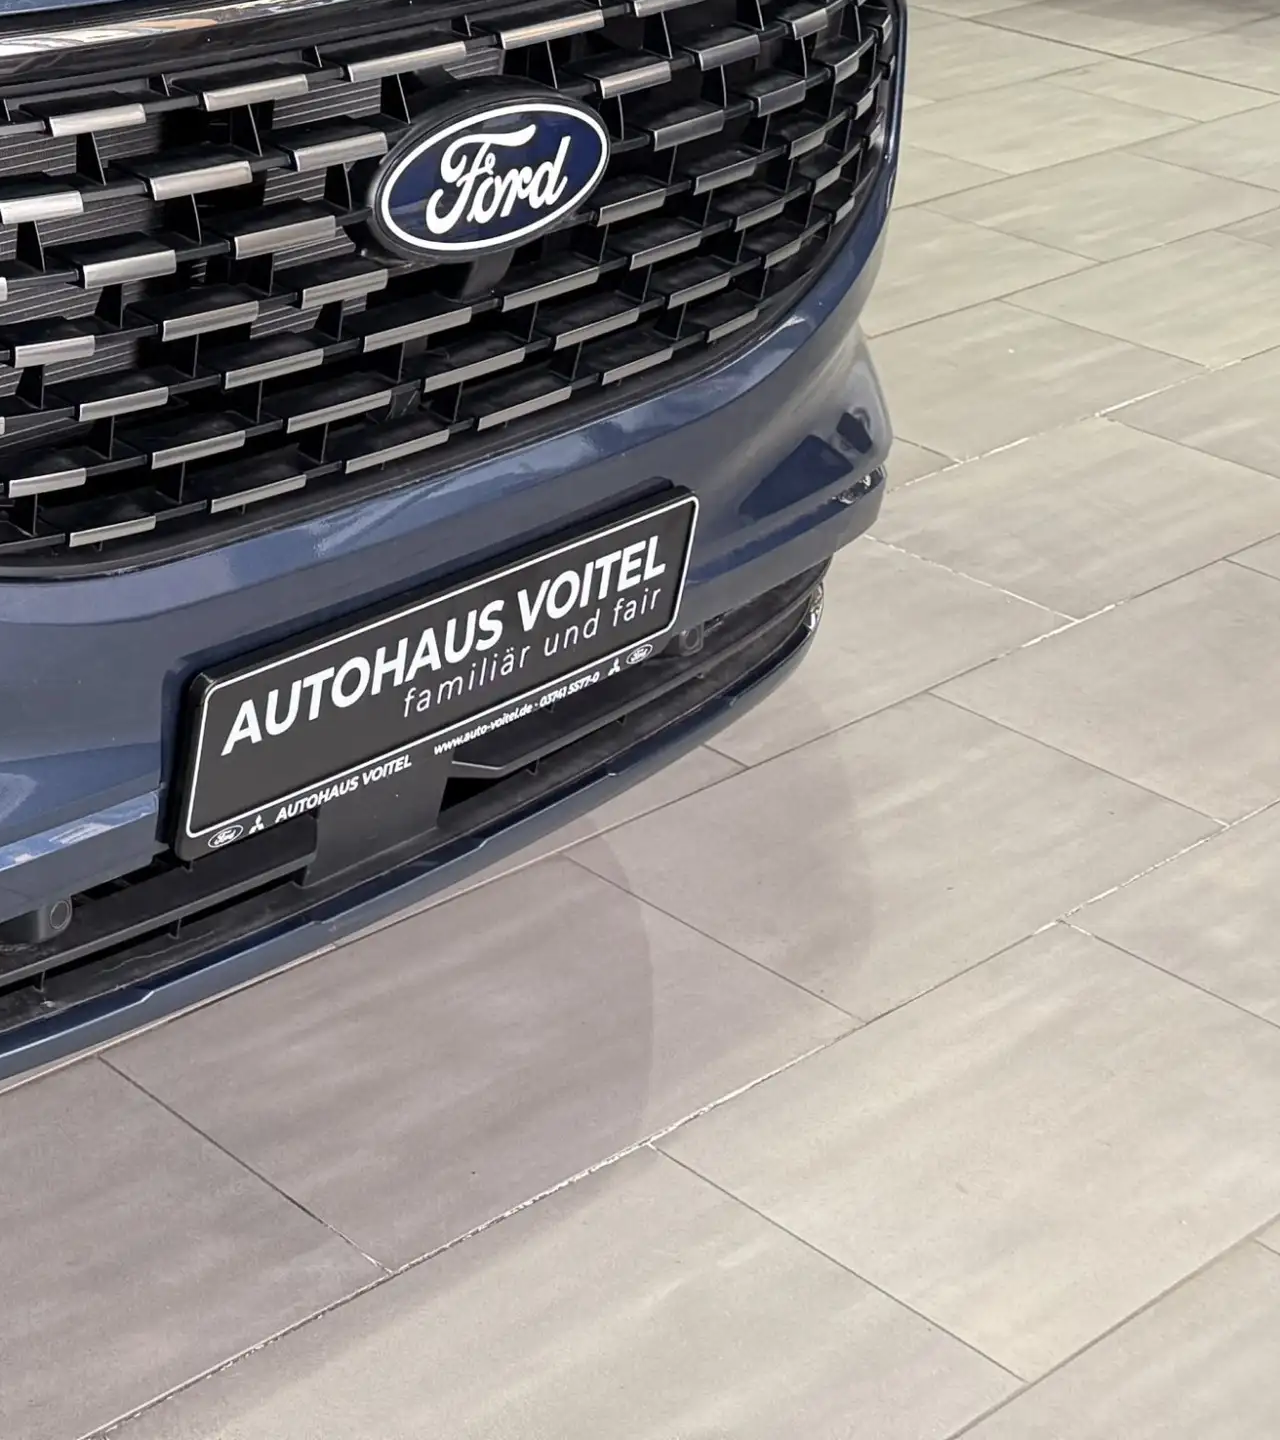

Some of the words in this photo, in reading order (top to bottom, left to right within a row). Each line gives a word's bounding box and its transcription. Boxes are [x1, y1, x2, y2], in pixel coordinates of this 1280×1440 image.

[423, 121, 574, 237] Ford
[220, 600, 505, 756] AUTOHAUS
[517, 534, 666, 626] VOITEL
[402, 644, 532, 718] familiär
[543, 611, 599, 658] und
[611, 588, 663, 629] fair
[433, 703, 534, 756] www.auto-voitel.de
[274, 777, 360, 824] AUTOHAUS
[361, 754, 413, 786] VOITEL
